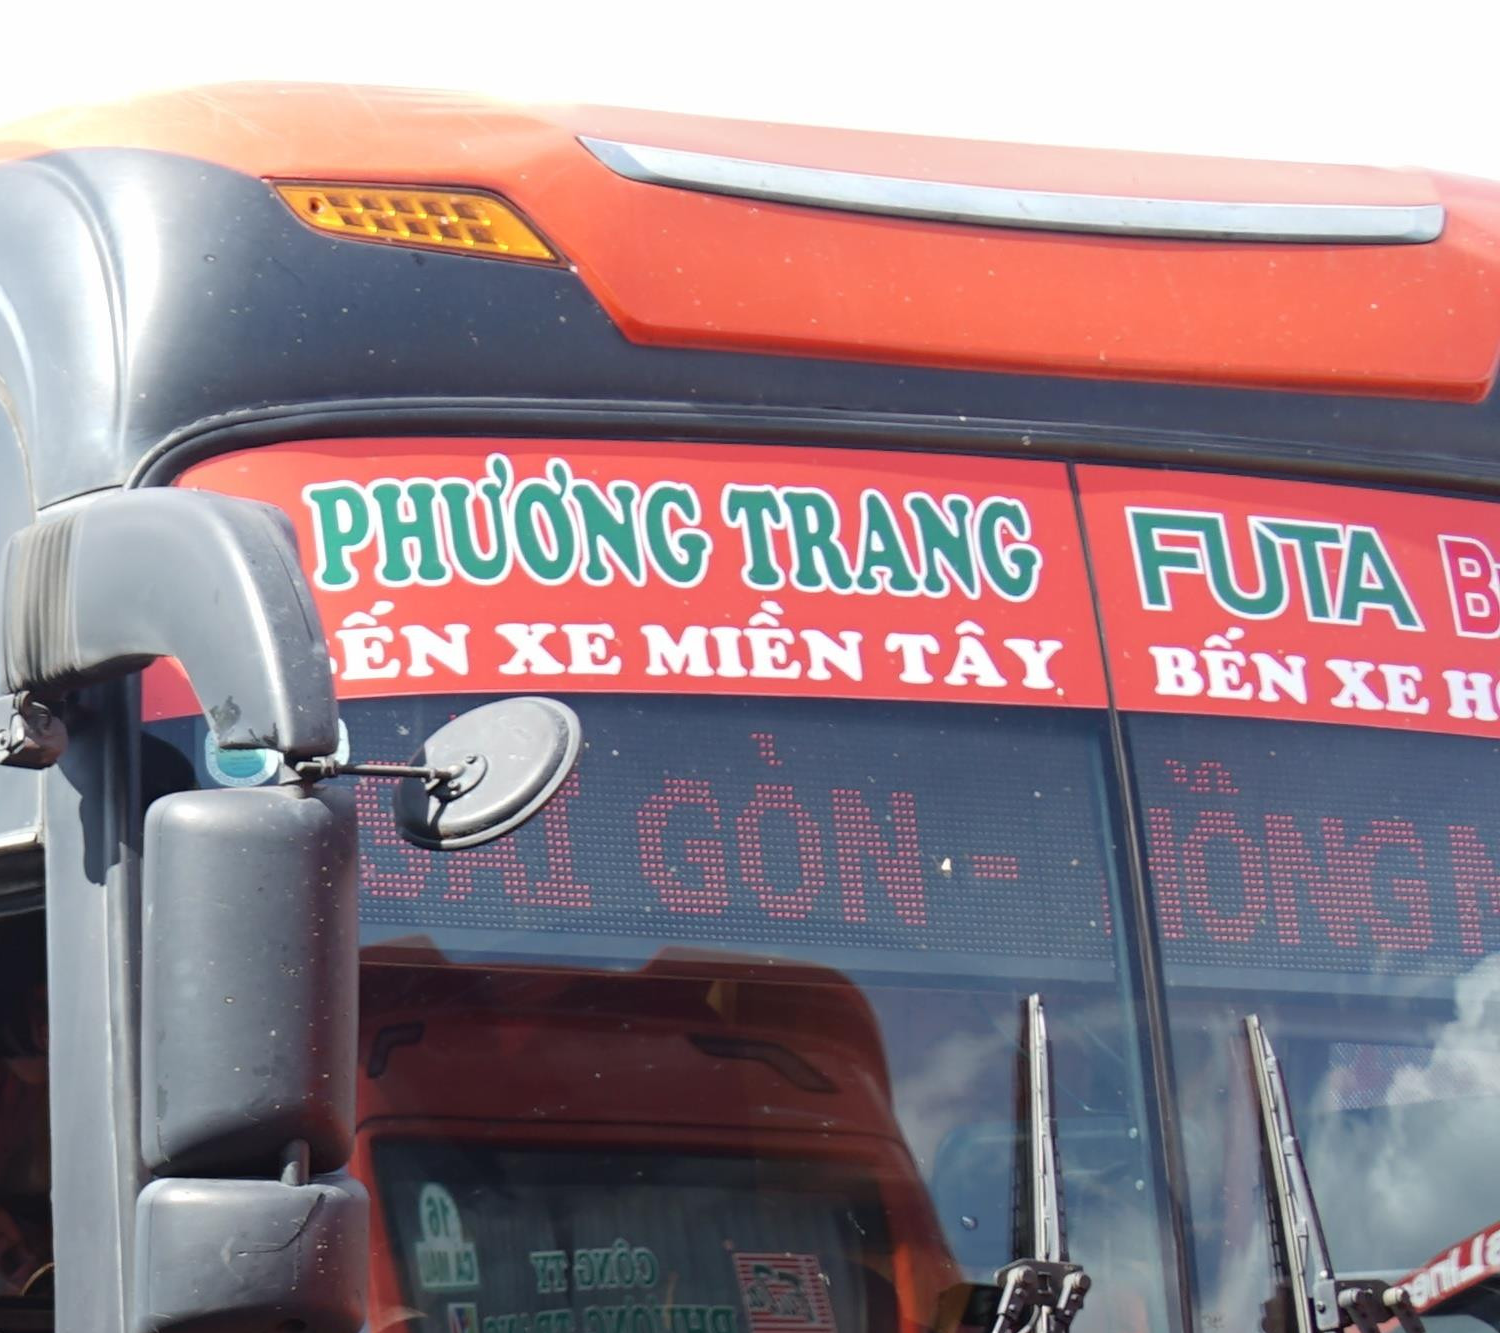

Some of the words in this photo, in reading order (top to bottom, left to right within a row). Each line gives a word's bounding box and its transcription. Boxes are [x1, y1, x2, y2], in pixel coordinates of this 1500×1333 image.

[303, 452, 714, 593] PHƯƠNG
[721, 482, 1043, 602] TRANG
[1124, 505, 1427, 632] FUTA
[1437, 534, 1500, 640] B
[326, 599, 471, 682] ẾN
[496, 622, 622, 677] XE
[641, 599, 864, 683] MIỀN
[884, 619, 1064, 691] TÂY
[1148, 626, 1308, 705] BẾN
[1325, 658, 1430, 716] XE
[1442, 668, 1500, 722] H
[636, 731, 927, 926] GÒN
